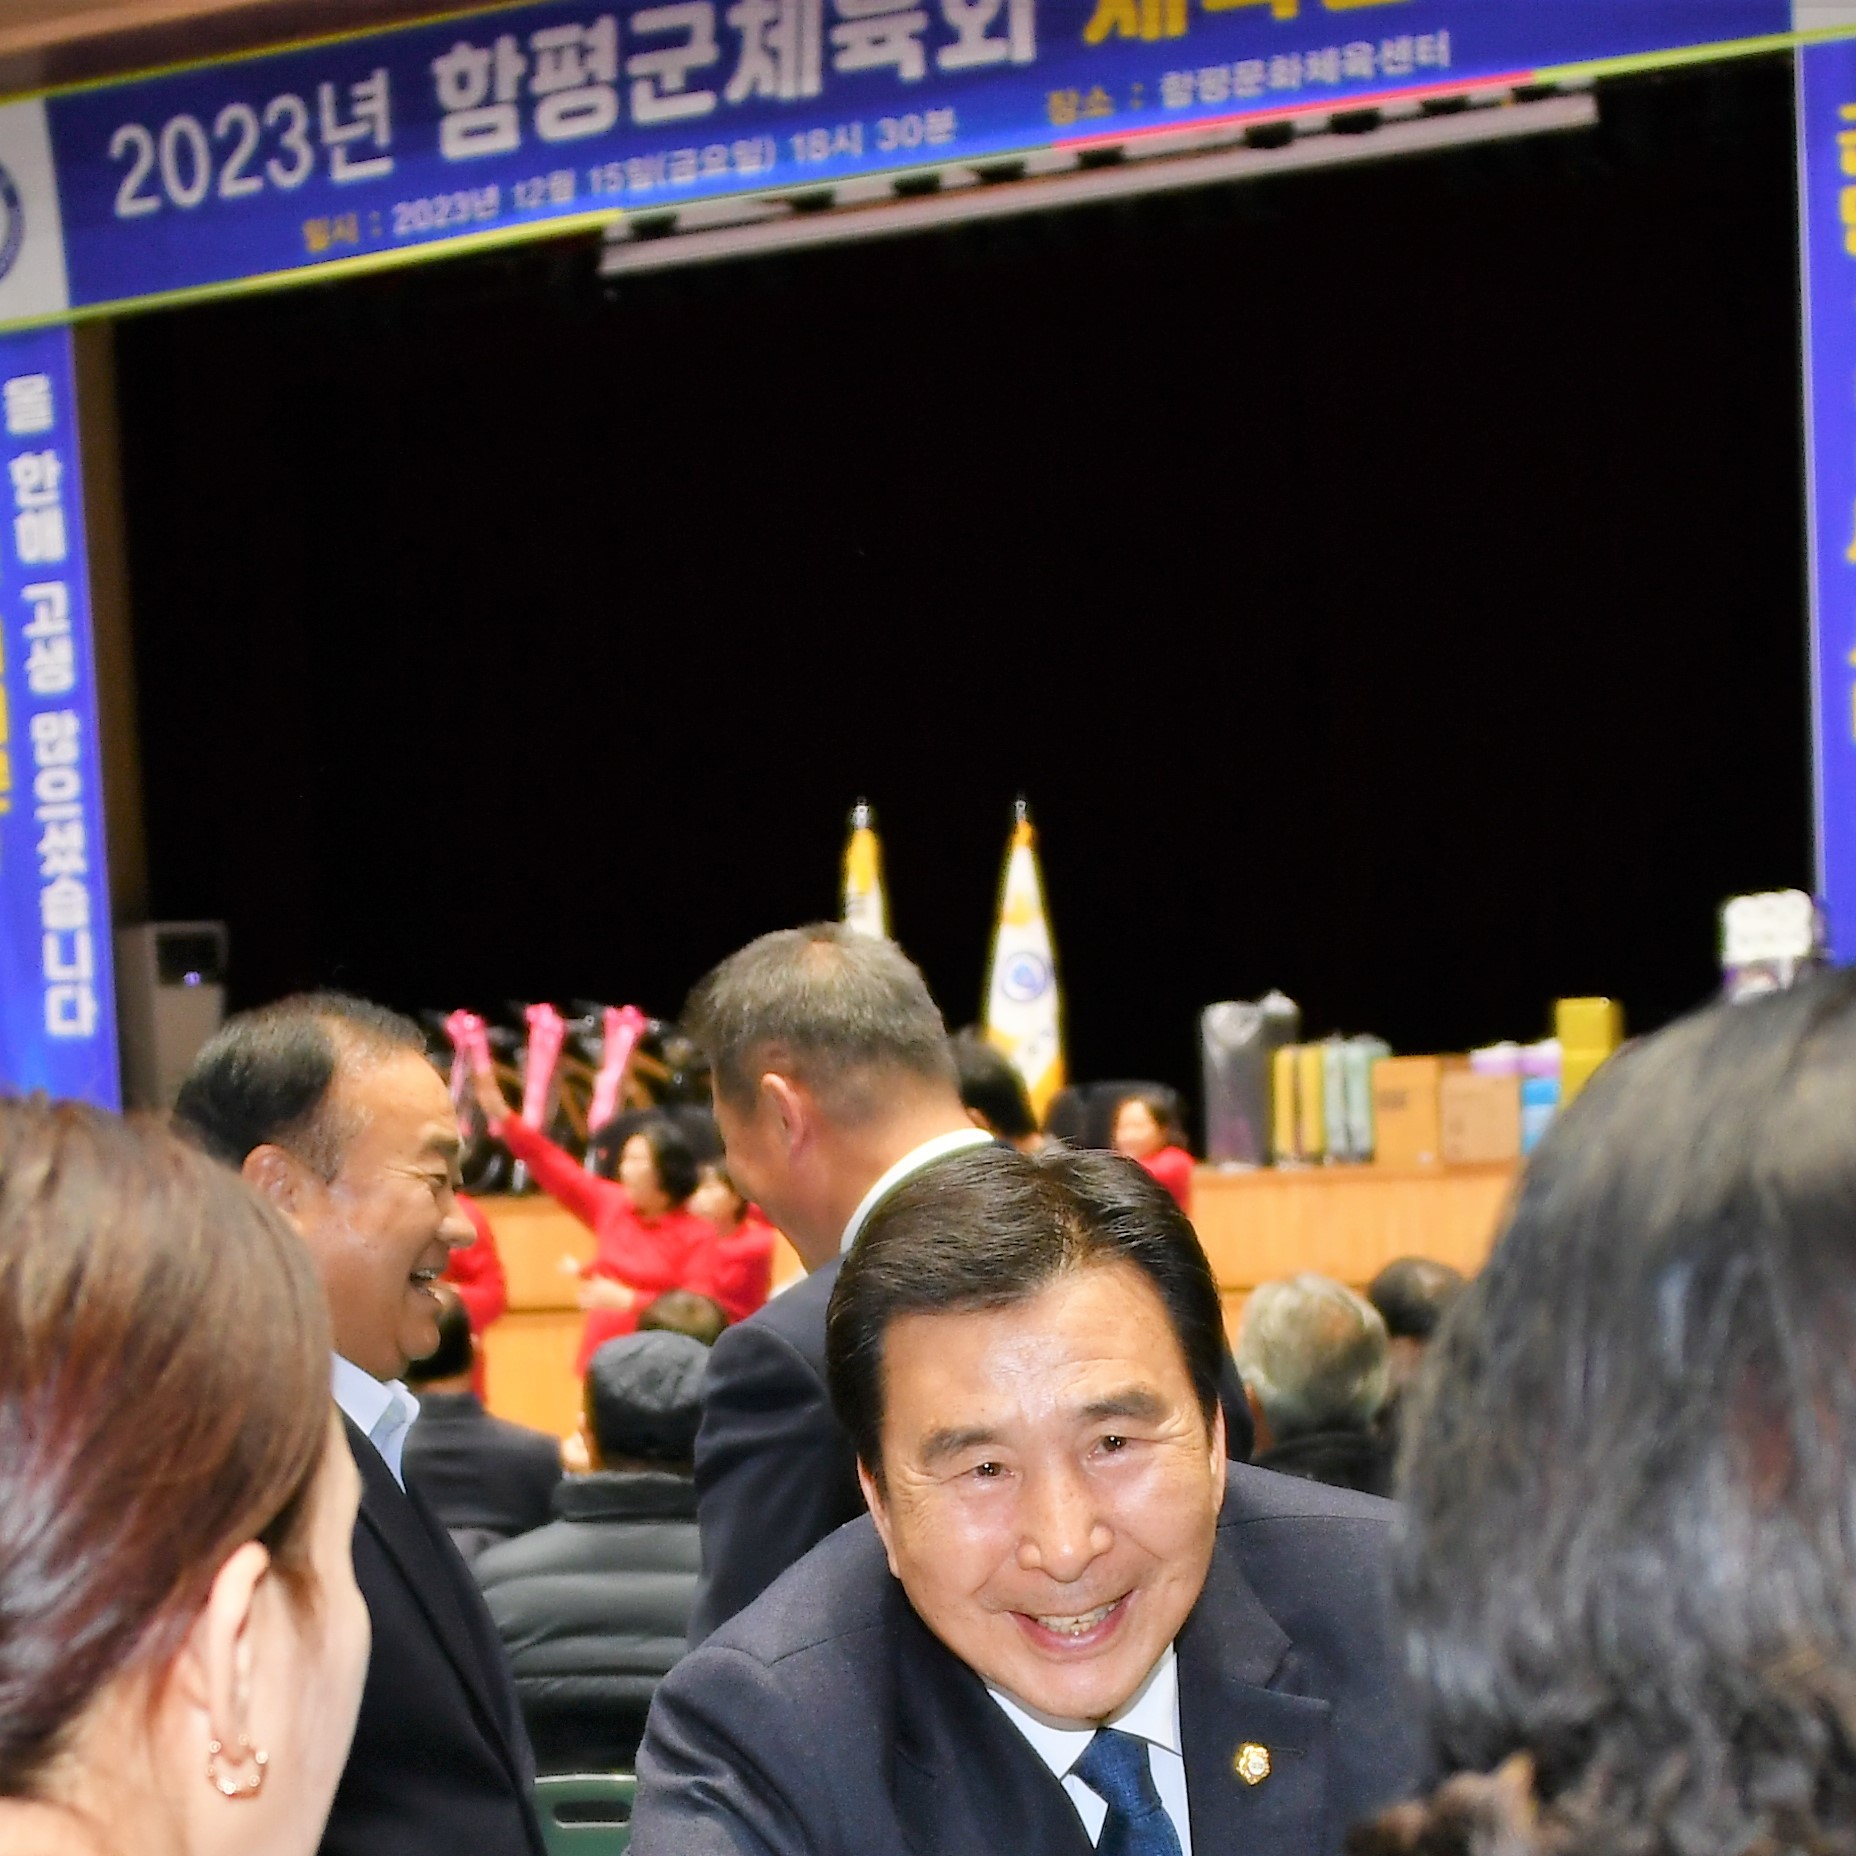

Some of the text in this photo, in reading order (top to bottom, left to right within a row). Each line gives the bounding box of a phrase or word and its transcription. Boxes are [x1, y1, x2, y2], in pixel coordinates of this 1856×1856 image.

[108, 0, 1038, 218] 2023년 함평군체육회
[1047, 85, 1114, 127] 장소
[1160, 30, 1451, 110] 함평문화체육센터
[302, 212, 360, 253] 일시
[392, 184, 501, 237] 2023년
[513, 168, 576, 210] 12월
[589, 135, 776, 196] 15일(금요일)
[790, 123, 865, 163] 18시
[877, 107, 957, 150] 30분
